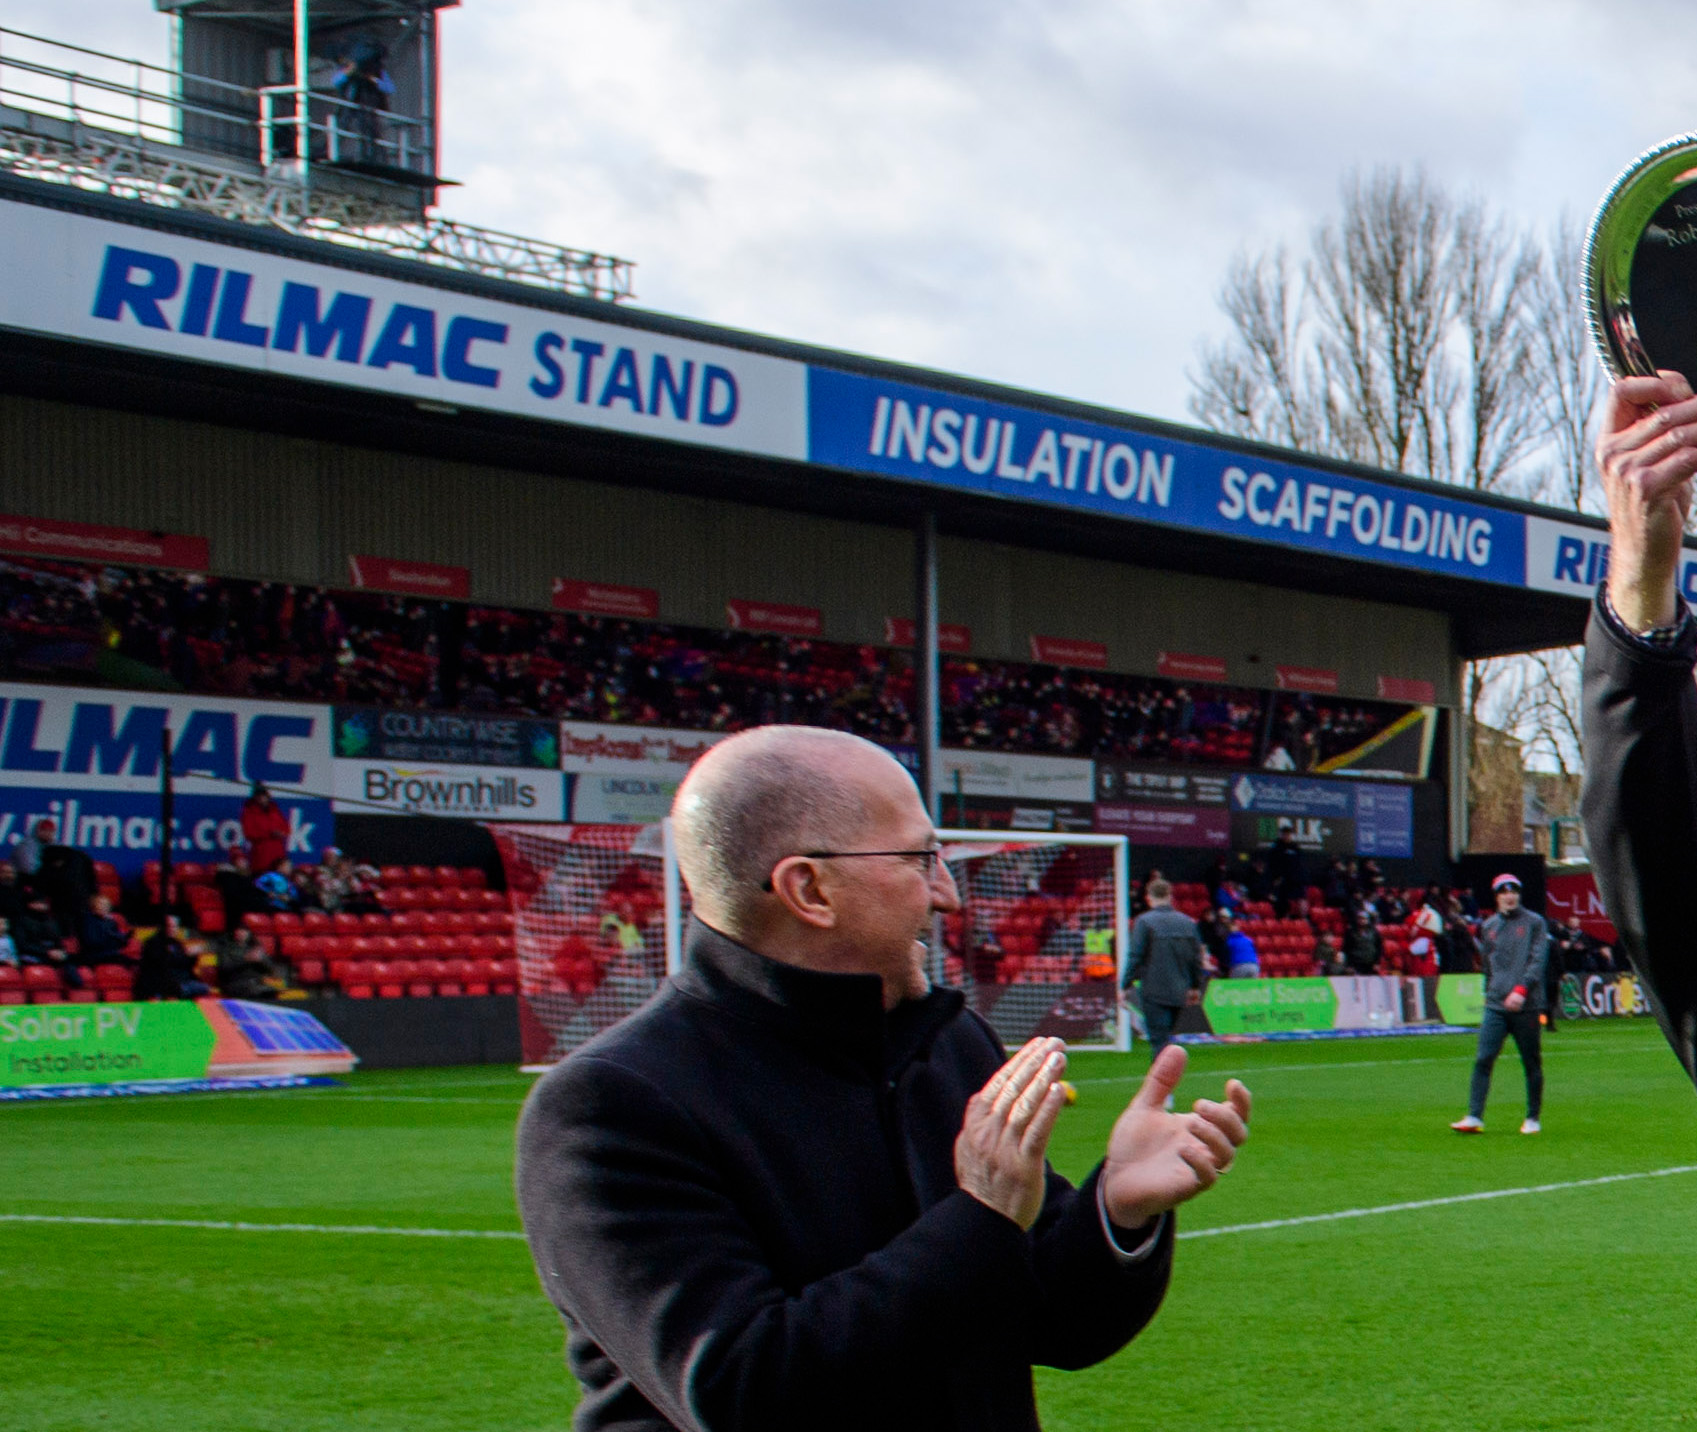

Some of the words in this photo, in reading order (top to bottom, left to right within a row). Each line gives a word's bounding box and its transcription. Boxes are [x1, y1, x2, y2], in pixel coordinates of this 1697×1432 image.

[91, 245, 509, 389] RILMAC
[529, 330, 741, 427] STAND
[869, 395, 1175, 508] INSULATION
[1218, 466, 1493, 567] SCAFFOLDING
[365, 769, 537, 808] Brownhills
[1213, 985, 1272, 1006] Ground
[1275, 983, 1331, 1004] Source
[1, 1008, 88, 1043] Solar
[96, 1006, 143, 1037] PV
[9, 1051, 143, 1074] Installation
